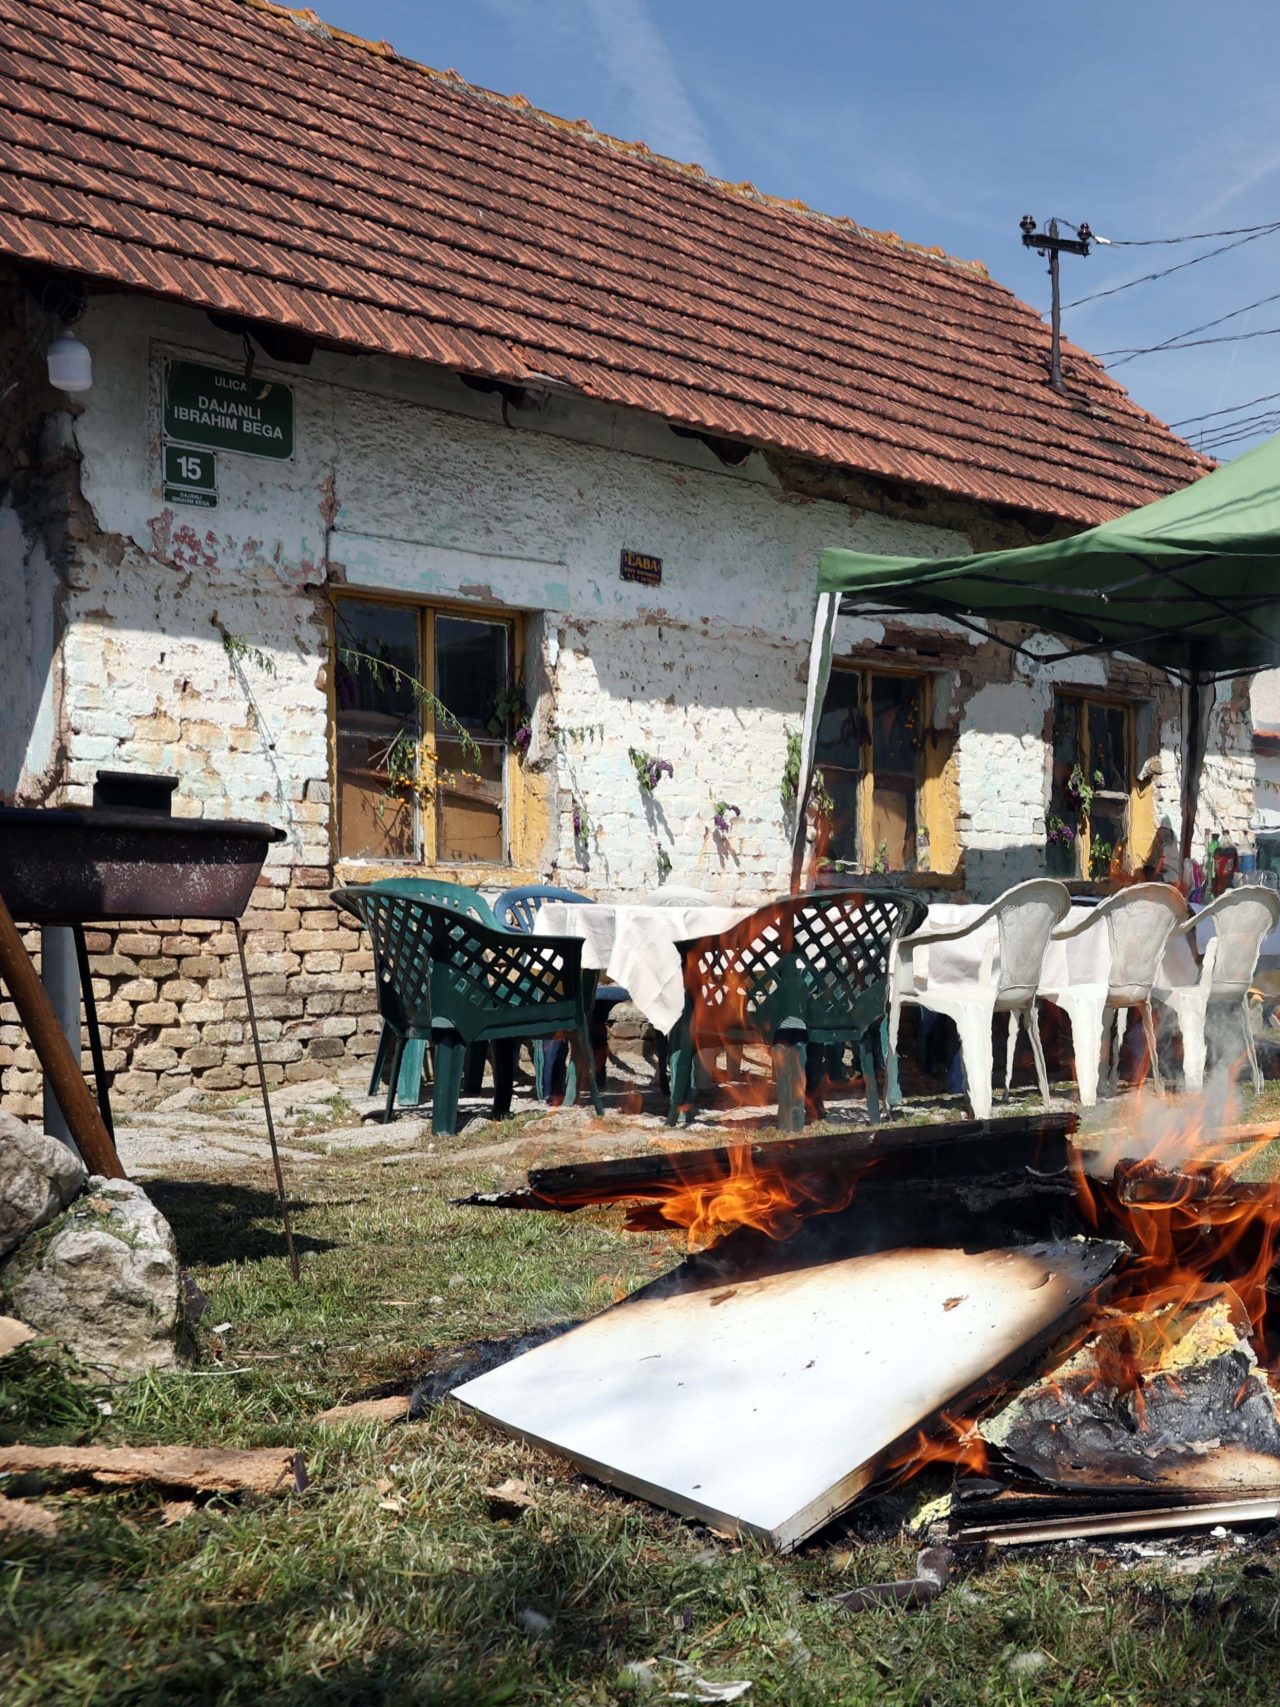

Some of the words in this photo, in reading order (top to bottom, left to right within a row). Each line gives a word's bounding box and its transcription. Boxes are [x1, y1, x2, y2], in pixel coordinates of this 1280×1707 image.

[214, 376, 248, 391] ULICA
[198, 396, 261, 420] DAJANLI
[174, 405, 237, 431] IBRAHIM
[242, 419, 284, 440] BEGA
[176, 455, 202, 480] 15
